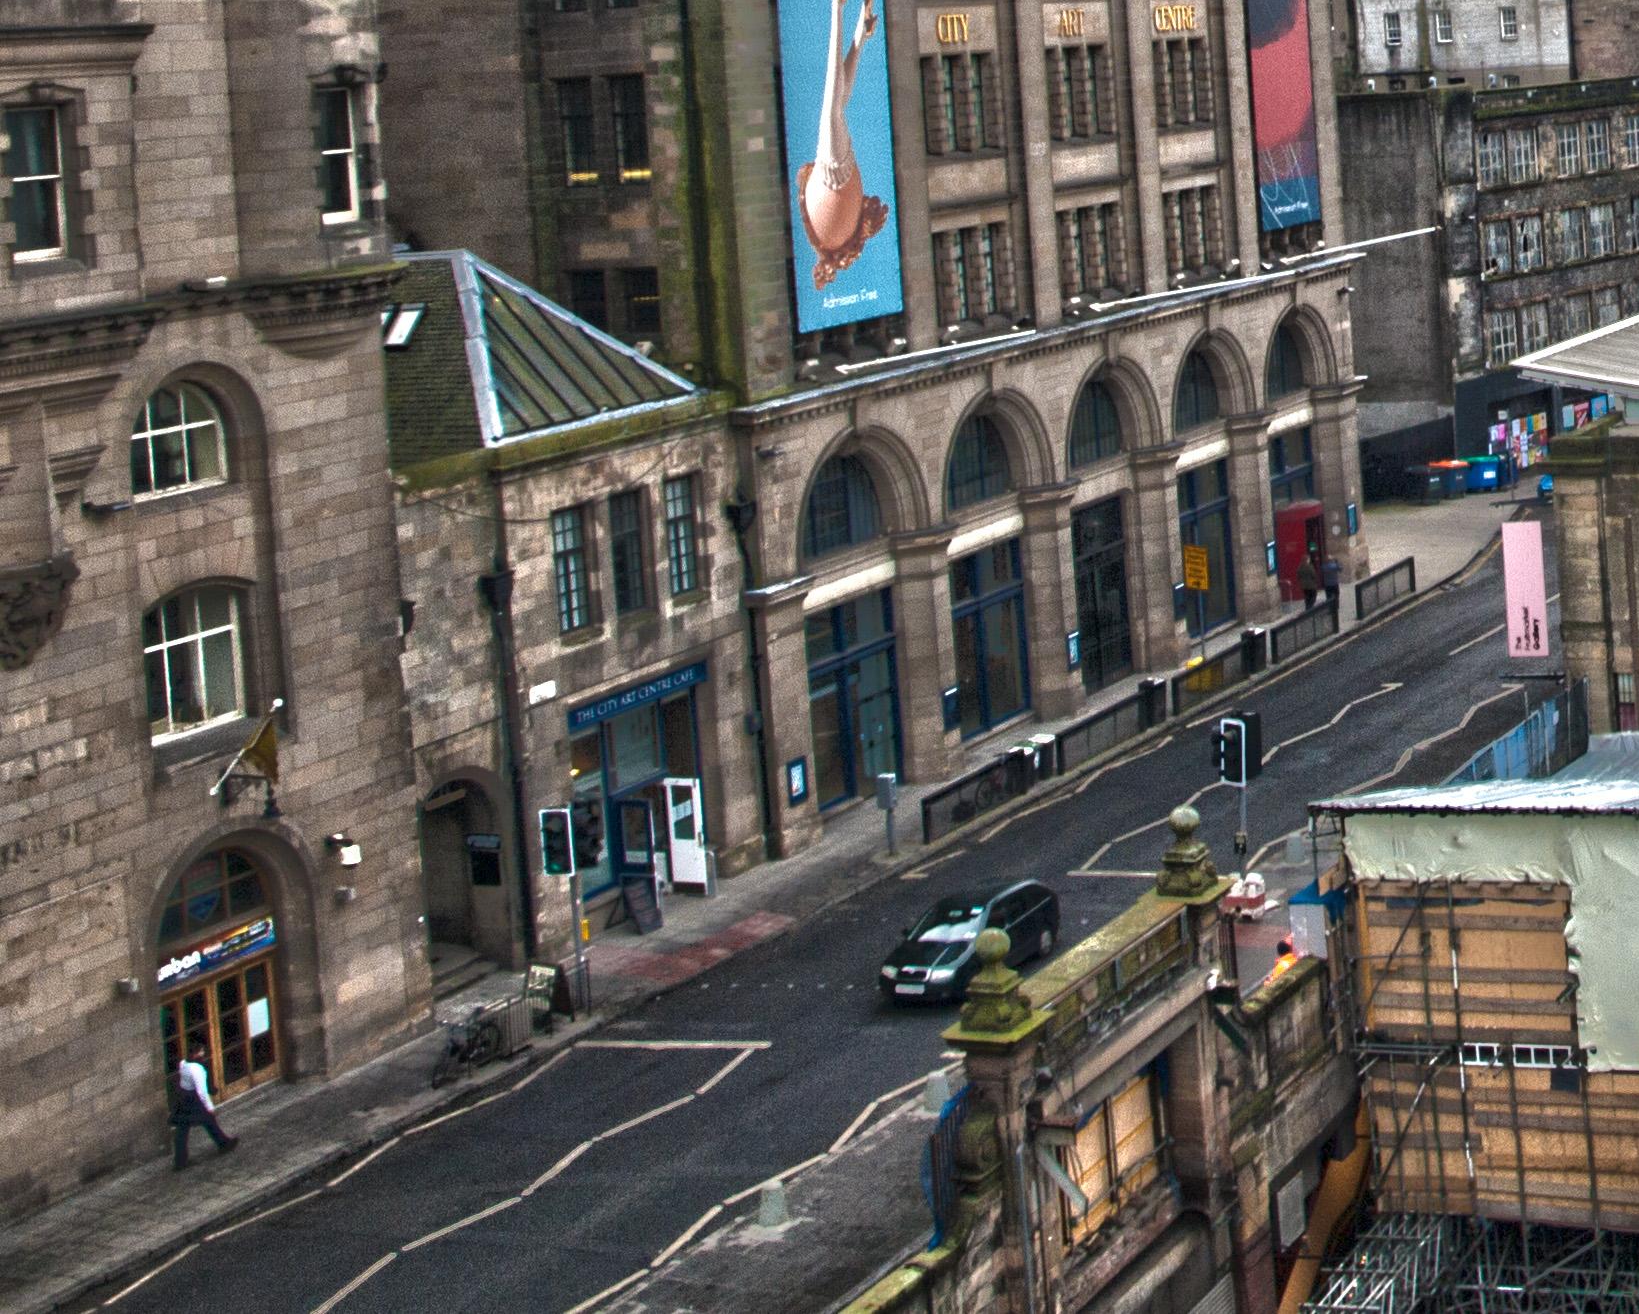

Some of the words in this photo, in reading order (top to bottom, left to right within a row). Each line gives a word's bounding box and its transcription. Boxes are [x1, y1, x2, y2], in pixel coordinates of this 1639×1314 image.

[933, 13, 970, 43] CITY
[1059, 8, 1086, 37] ART
[1153, 3, 1195, 32] CENTRE
[823, 292, 860, 308] Admission
[860, 288, 879, 302] Free
[1532, 618, 1541, 651] Gallery
[576, 710, 595, 723] THE
[597, 699, 617, 716] CITY
[621, 690, 637, 706] ART
[638, 677, 671, 699] CENTRE
